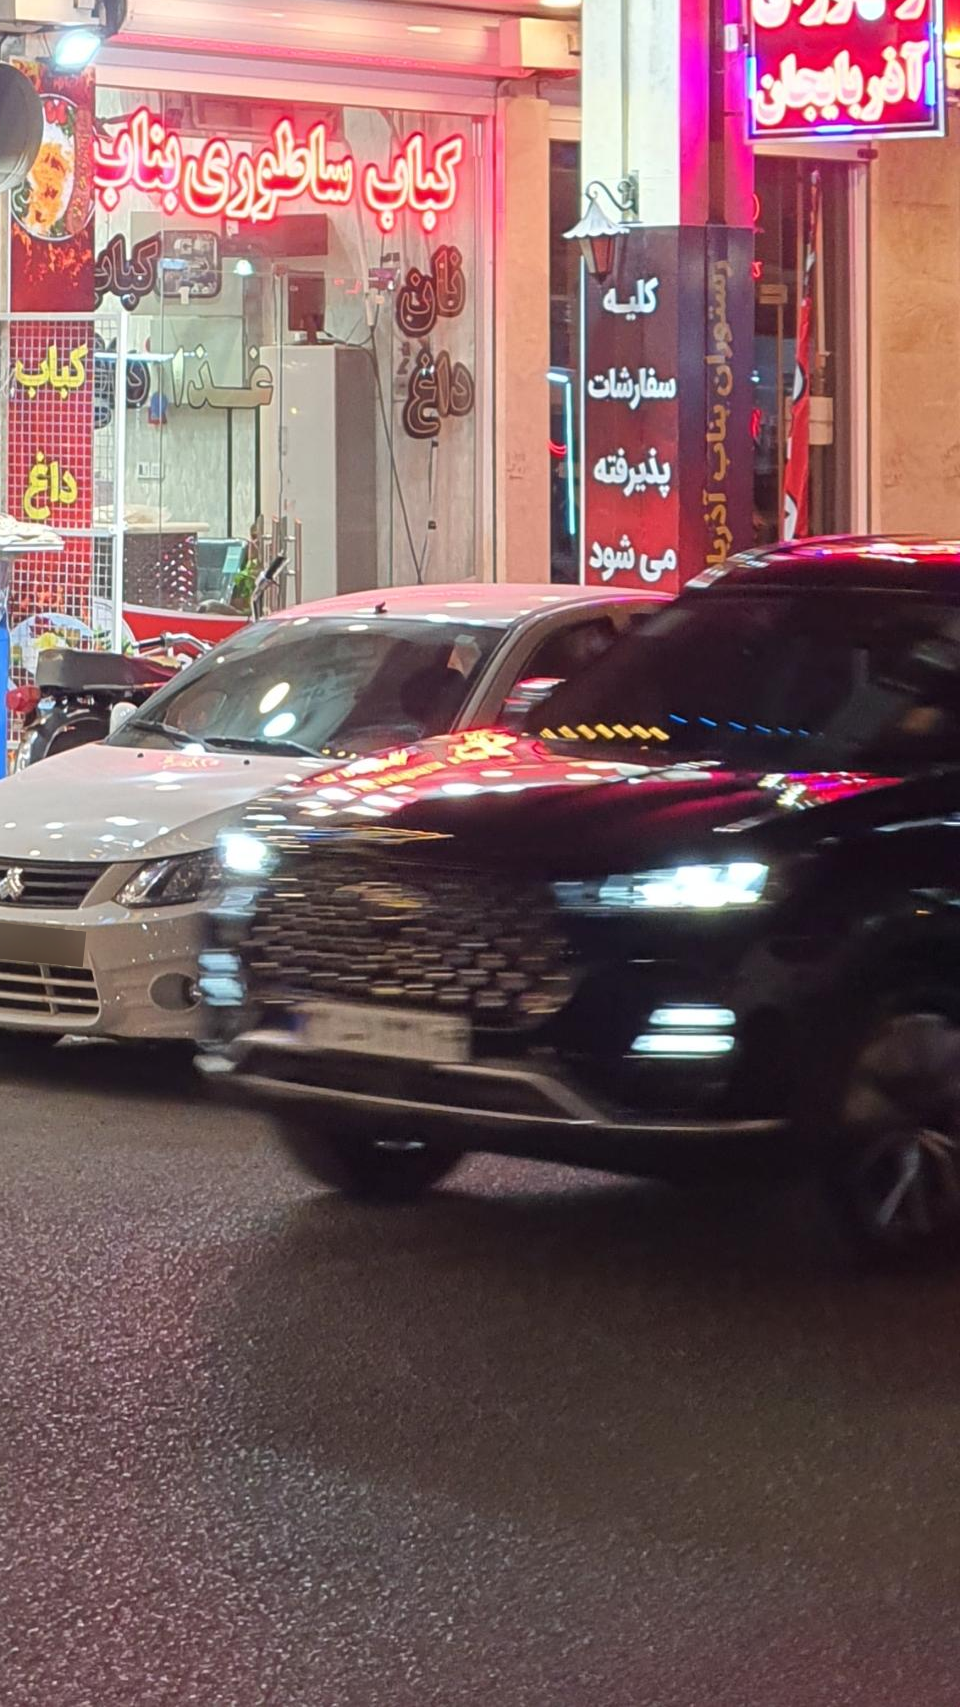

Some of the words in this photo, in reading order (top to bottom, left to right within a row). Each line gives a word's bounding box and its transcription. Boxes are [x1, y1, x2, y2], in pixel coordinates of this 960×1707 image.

[754, 39, 930, 126] آذربایجان
[93, 105, 184, 214] بناب
[183, 116, 354, 222] ساطوری
[363, 131, 464, 235] کباب
[396, 244, 466, 339] نان
[602, 276, 659, 321] کلیه
[703, 259, 733, 396] رستوران
[15, 343, 89, 400] کباب
[171, 344, 274, 410] غذا
[402, 349, 475, 440] داغ
[587, 366, 677, 410] سفارشات
[593, 448, 672, 498] پذیرفته
[705, 402, 732, 483] بناب
[22, 451, 77, 521] داغ
[588, 534, 637, 581] شود
[639, 547, 677, 583] می
[702, 488, 733, 565] آذربا
